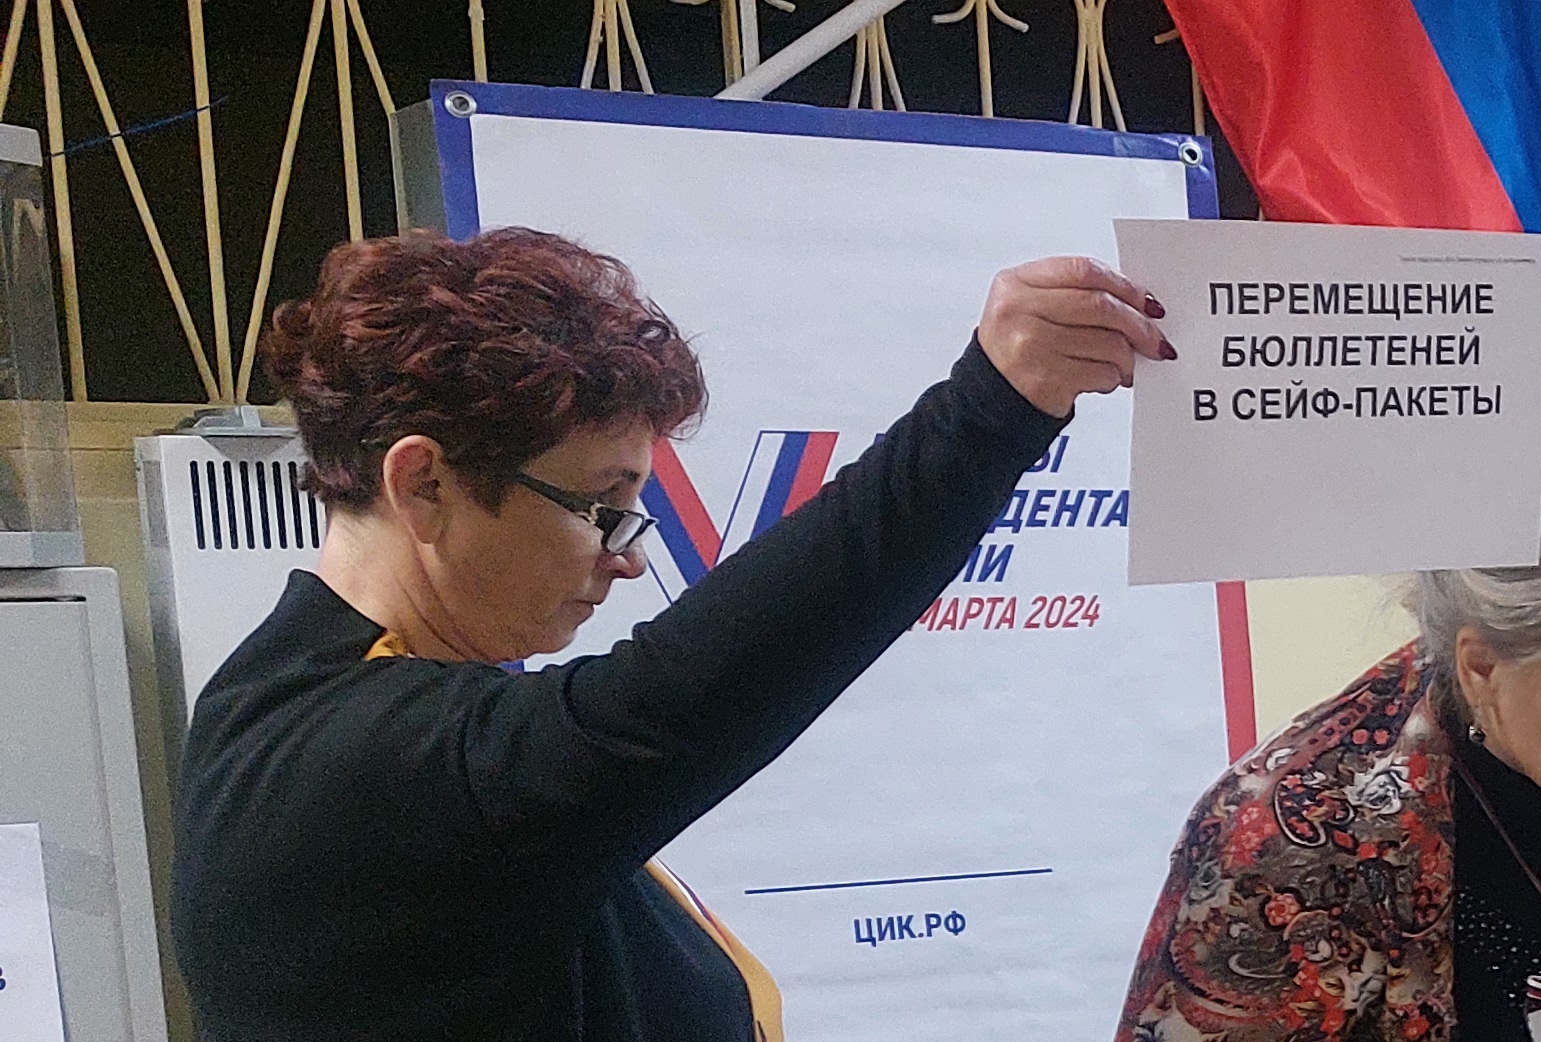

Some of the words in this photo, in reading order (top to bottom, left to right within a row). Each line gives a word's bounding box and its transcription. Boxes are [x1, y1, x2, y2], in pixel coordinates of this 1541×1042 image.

[1208, 282, 1495, 321] ПЕРЕМЕЩЕНИЕ
[1221, 325, 1480, 368] БЮЛЛЕТЕНЕЙ
[1193, 389, 1218, 421] В
[1231, 379, 1502, 420] СЕЙФ-ПАКЕТЫ
[1023, 594, 1101, 630] 2024
[853, 910, 966, 948] ЦИК.РФ
